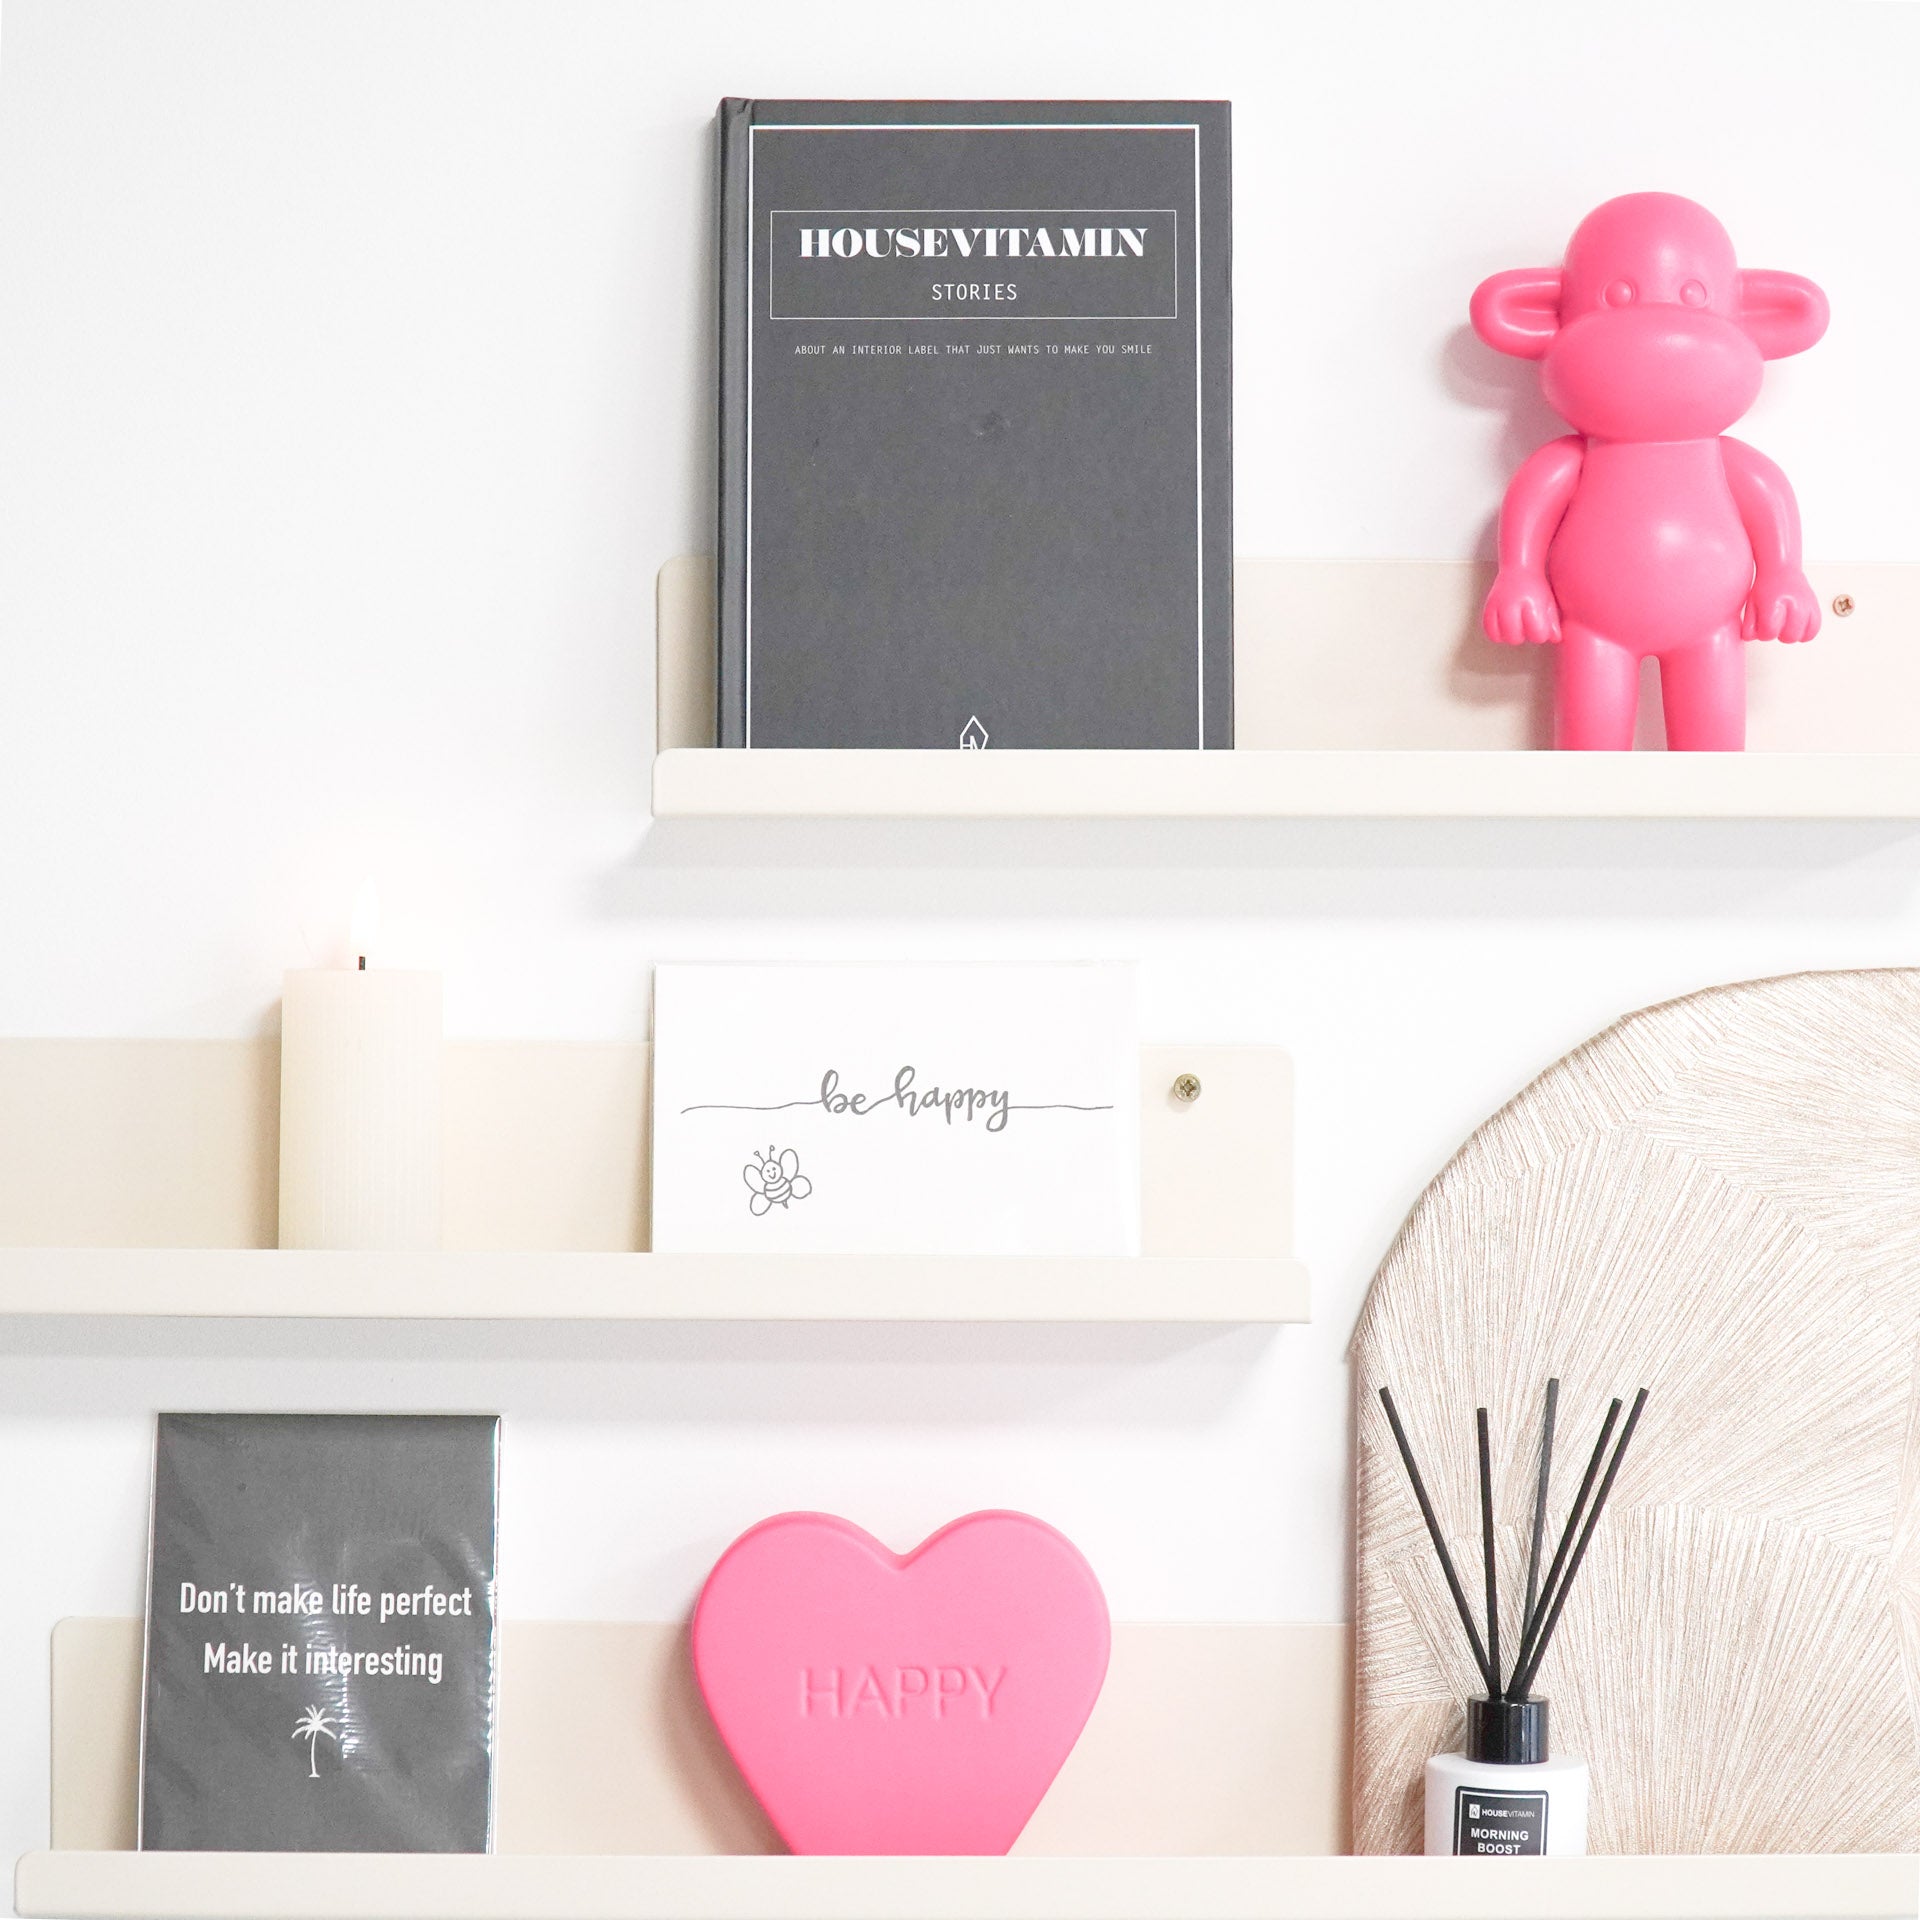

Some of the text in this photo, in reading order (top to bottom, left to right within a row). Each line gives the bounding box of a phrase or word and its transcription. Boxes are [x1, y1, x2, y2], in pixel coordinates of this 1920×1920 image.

[798, 227, 1148, 258] HOUSEVITAMIN
[932, 283, 1018, 301] STORIES
[794, 344, 1153, 355] ABOUT AN INTERIOR LABEL THAT JUST WANTS TO MAKE YOU SMILE
[820, 1065, 1009, 1133] be happy
[253, 1583, 324, 1615] make
[332, 1584, 372, 1615] life
[380, 1584, 472, 1624] perfect
[203, 1642, 443, 1684] Make it interesting
[801, 1664, 1009, 1720] HAPPY
[1481, 1808, 1535, 1818] HOUSEVITAMIN
[1470, 1827, 1529, 1841] MORNING
[1477, 1842, 1521, 1855] BOOST
